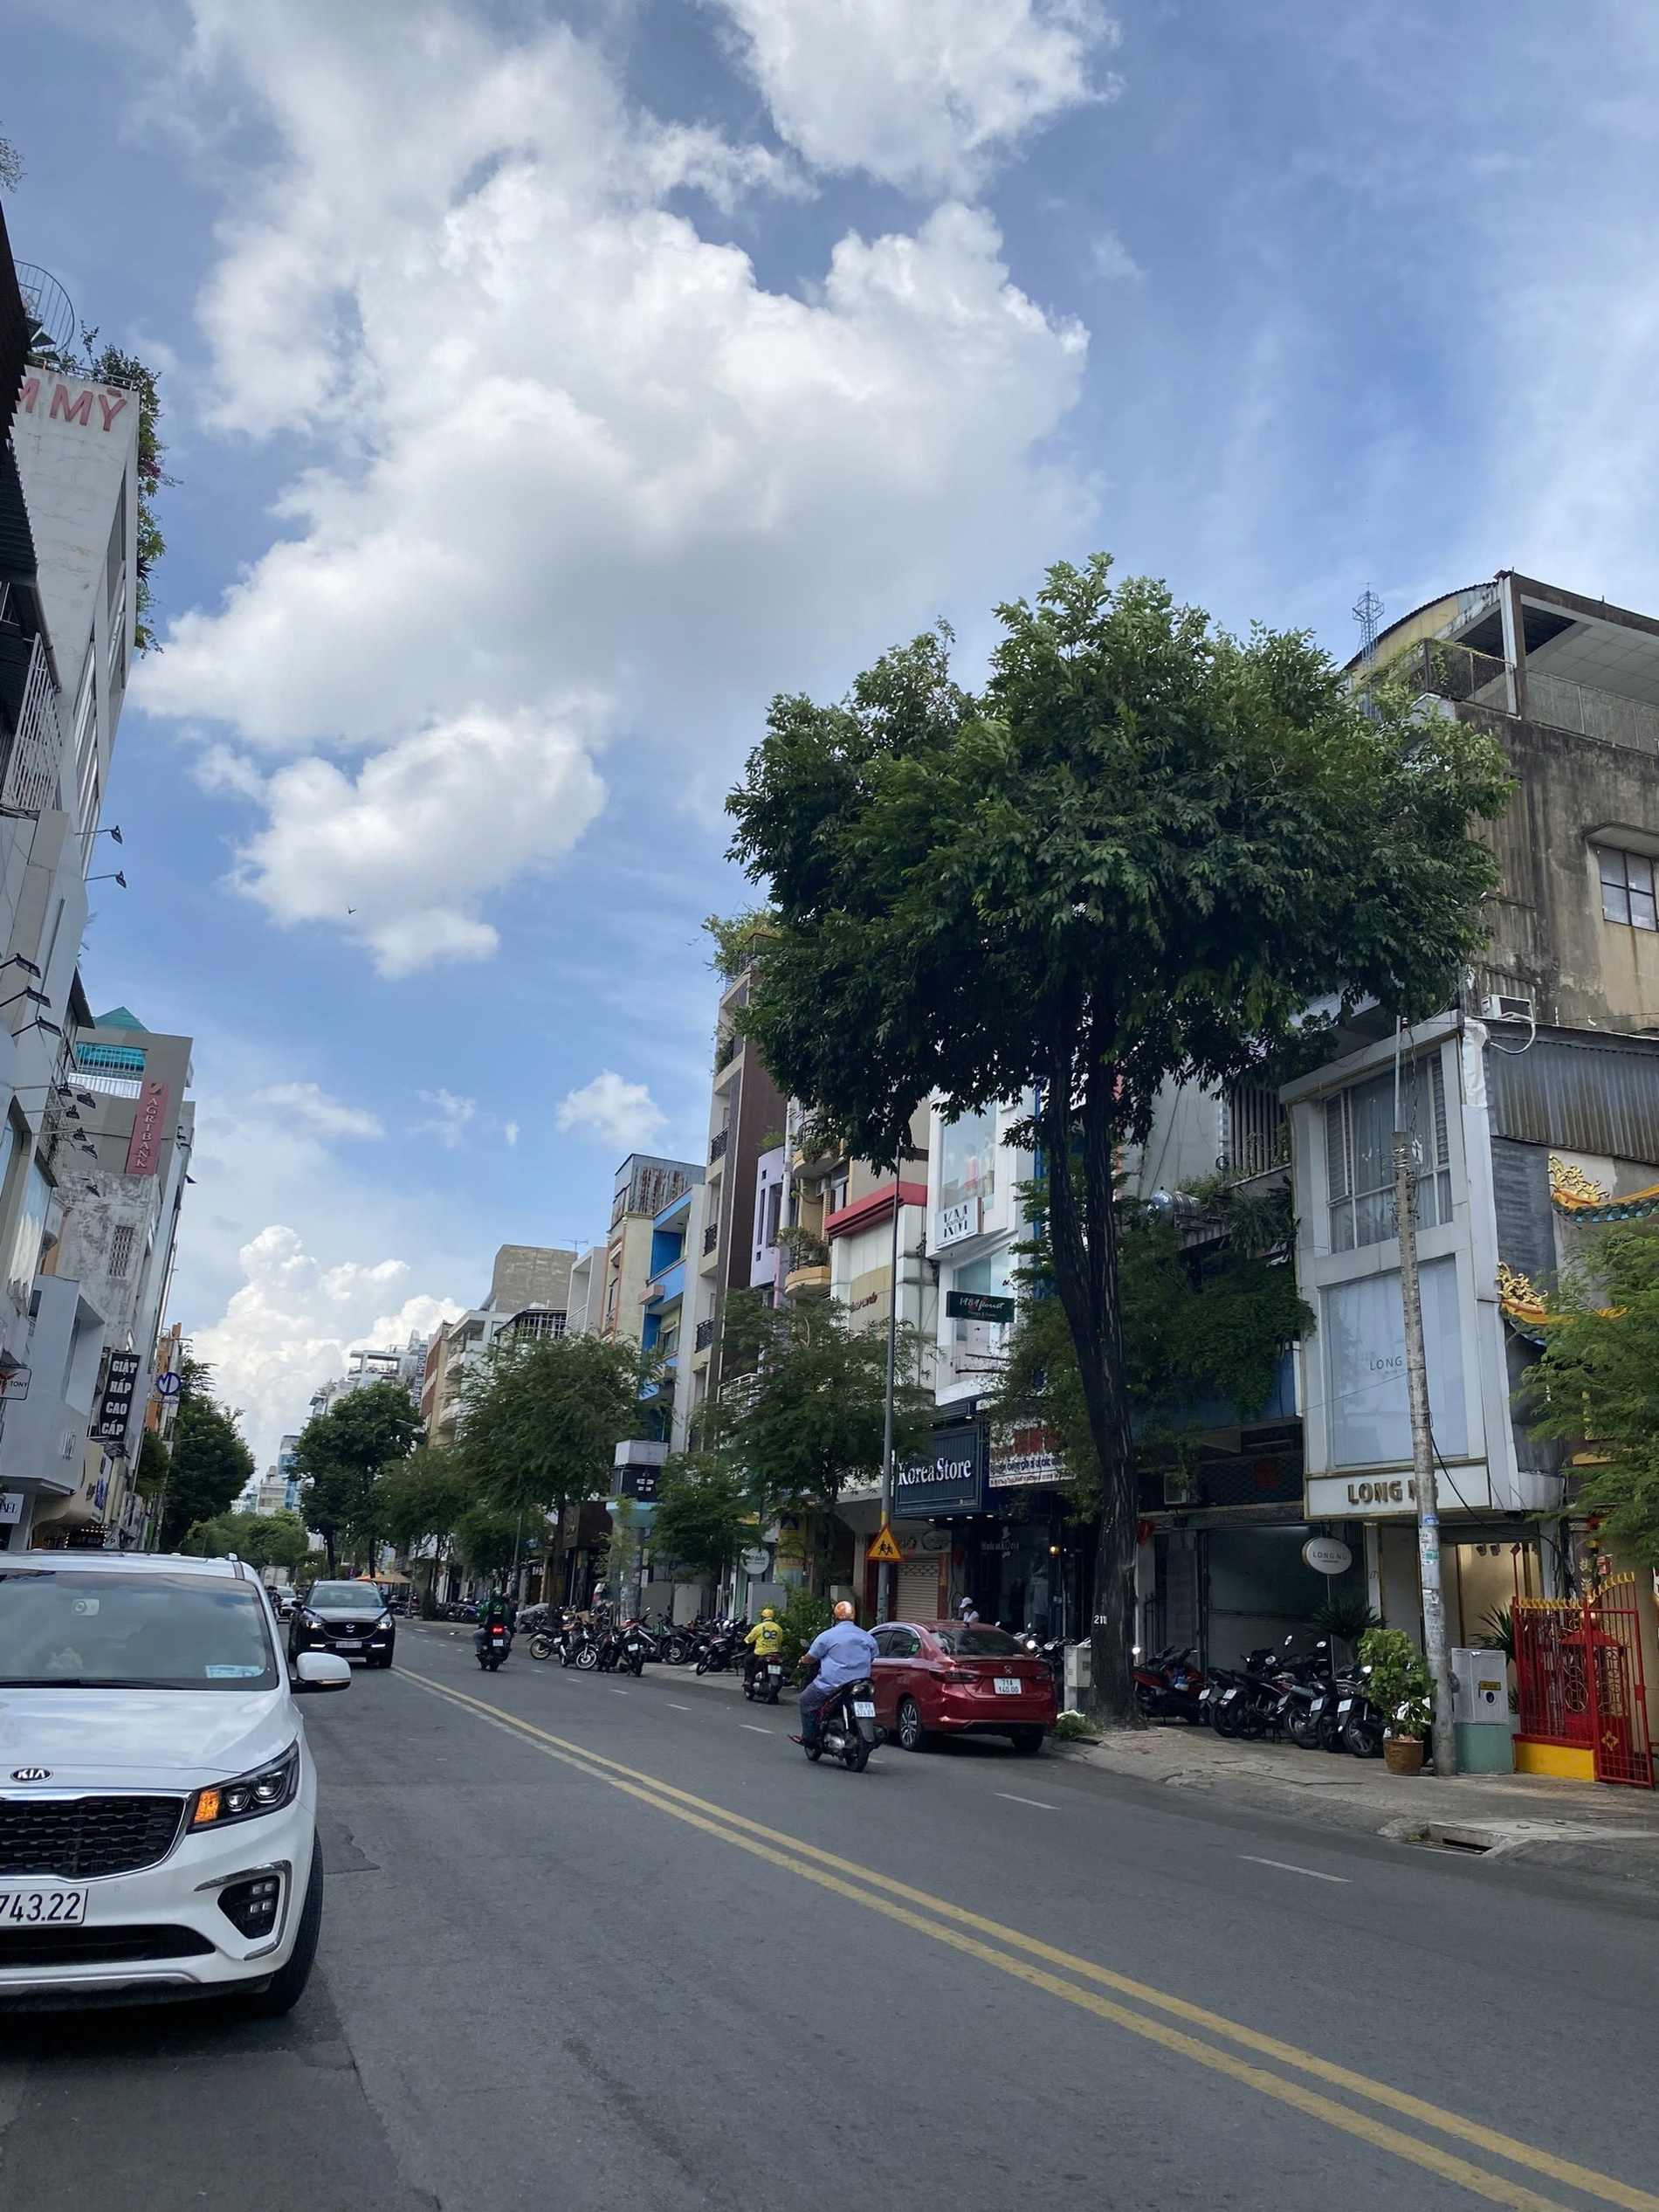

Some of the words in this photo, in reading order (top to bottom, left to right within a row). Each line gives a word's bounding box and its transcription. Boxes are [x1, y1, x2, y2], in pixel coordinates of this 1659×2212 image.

[136, 1098, 158, 1168] AGRIBANK
[1370, 1355, 1402, 1371] LONG
[106, 1402, 127, 1416] CAO
[936, 1457, 972, 1481] Store
[1347, 1480, 1403, 1505] LONG
[1312, 1551, 1335, 1560] LONG
[762, 1625, 778, 1640] be
[17, 1768, 46, 1780] KIA
